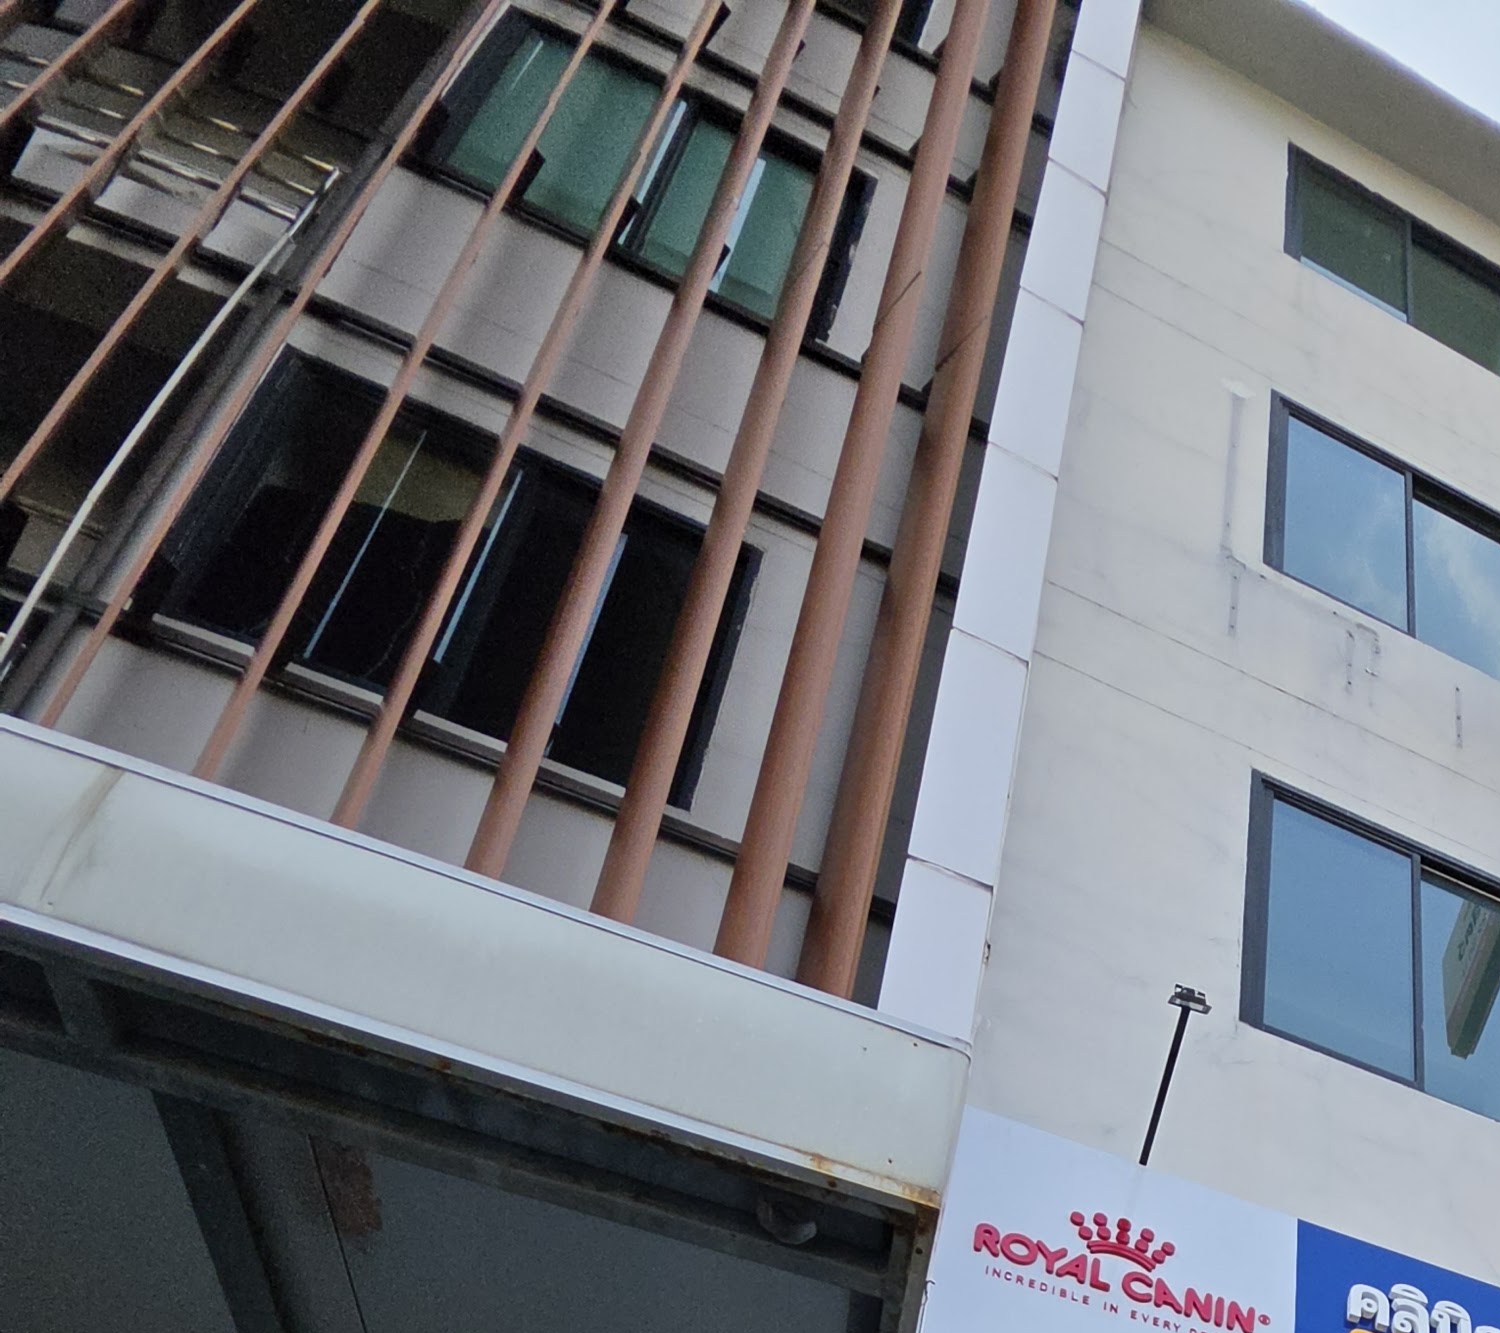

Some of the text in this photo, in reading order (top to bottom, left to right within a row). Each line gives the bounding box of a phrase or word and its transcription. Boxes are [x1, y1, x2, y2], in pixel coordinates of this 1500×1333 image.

[973, 1222, 1111, 1293] ROYAL
[984, 1264, 1091, 1307] INCREDIBLE
[1103, 1300, 1119, 1315] IN
[1130, 1309, 1181, 1333] EVERY
